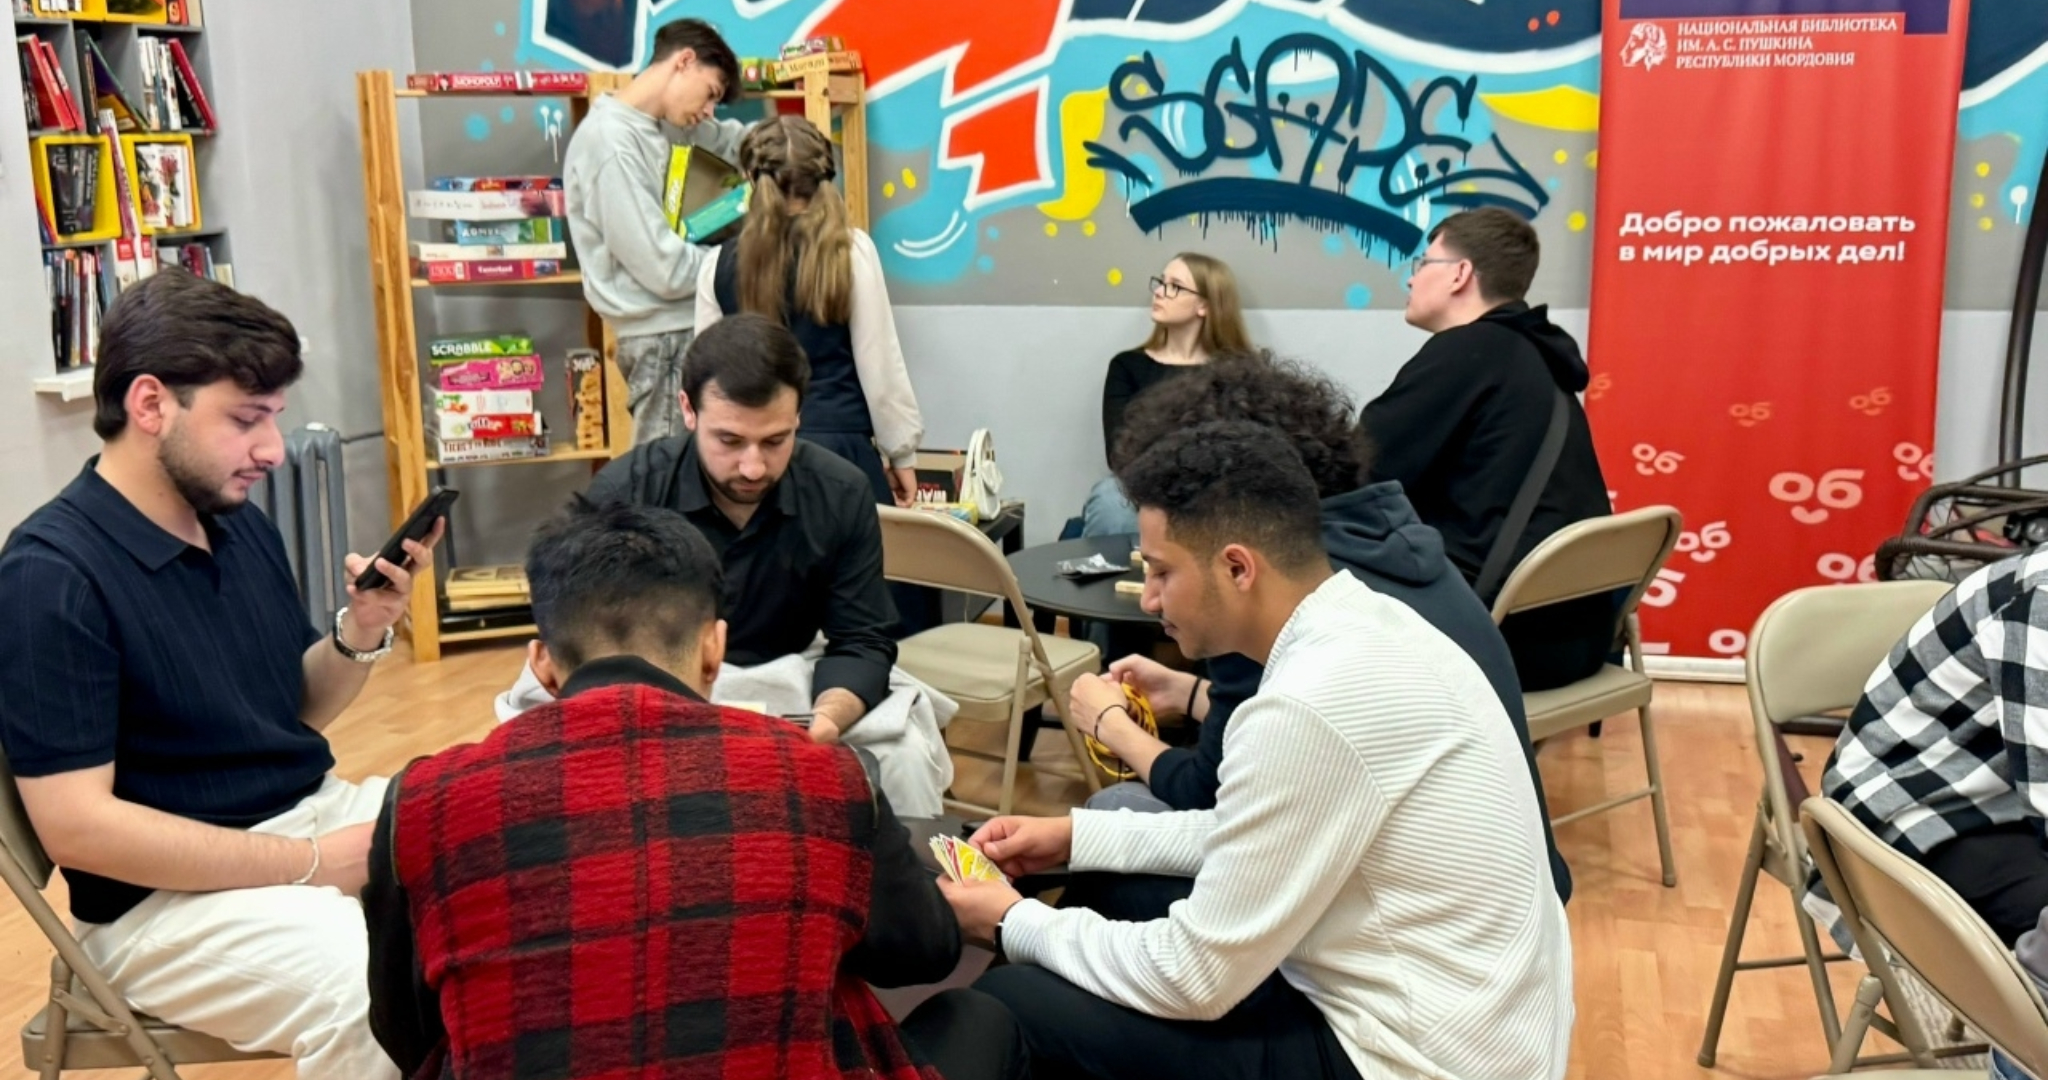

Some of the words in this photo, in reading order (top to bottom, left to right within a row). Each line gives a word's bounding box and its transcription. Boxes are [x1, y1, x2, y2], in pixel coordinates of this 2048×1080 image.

[1678, 20, 1798, 36] НАЦИОНАЛЬНАЯ
[1801, 18, 1897, 33] БИБЛИОТЕКА
[1677, 39, 1704, 52] ИМ.
[1706, 38, 1720, 51] А.
[1723, 38, 1736, 50] С.
[1739, 36, 1813, 50] ПУШКИНА
[1676, 54, 1770, 69] РЕСПУБЛИКИ
[1773, 52, 1855, 68] МОРДОВИЯ
[454, 75, 500, 89] MONOPOLY
[1619, 210, 1722, 237] Добро
[1728, 215, 1916, 232] пожаловать
[1619, 245, 1636, 261] в
[1643, 244, 1704, 266] мир
[1708, 239, 1831, 266] добрых
[1836, 241, 1905, 264] дел!
[431, 340, 493, 356] SCRABBLE
